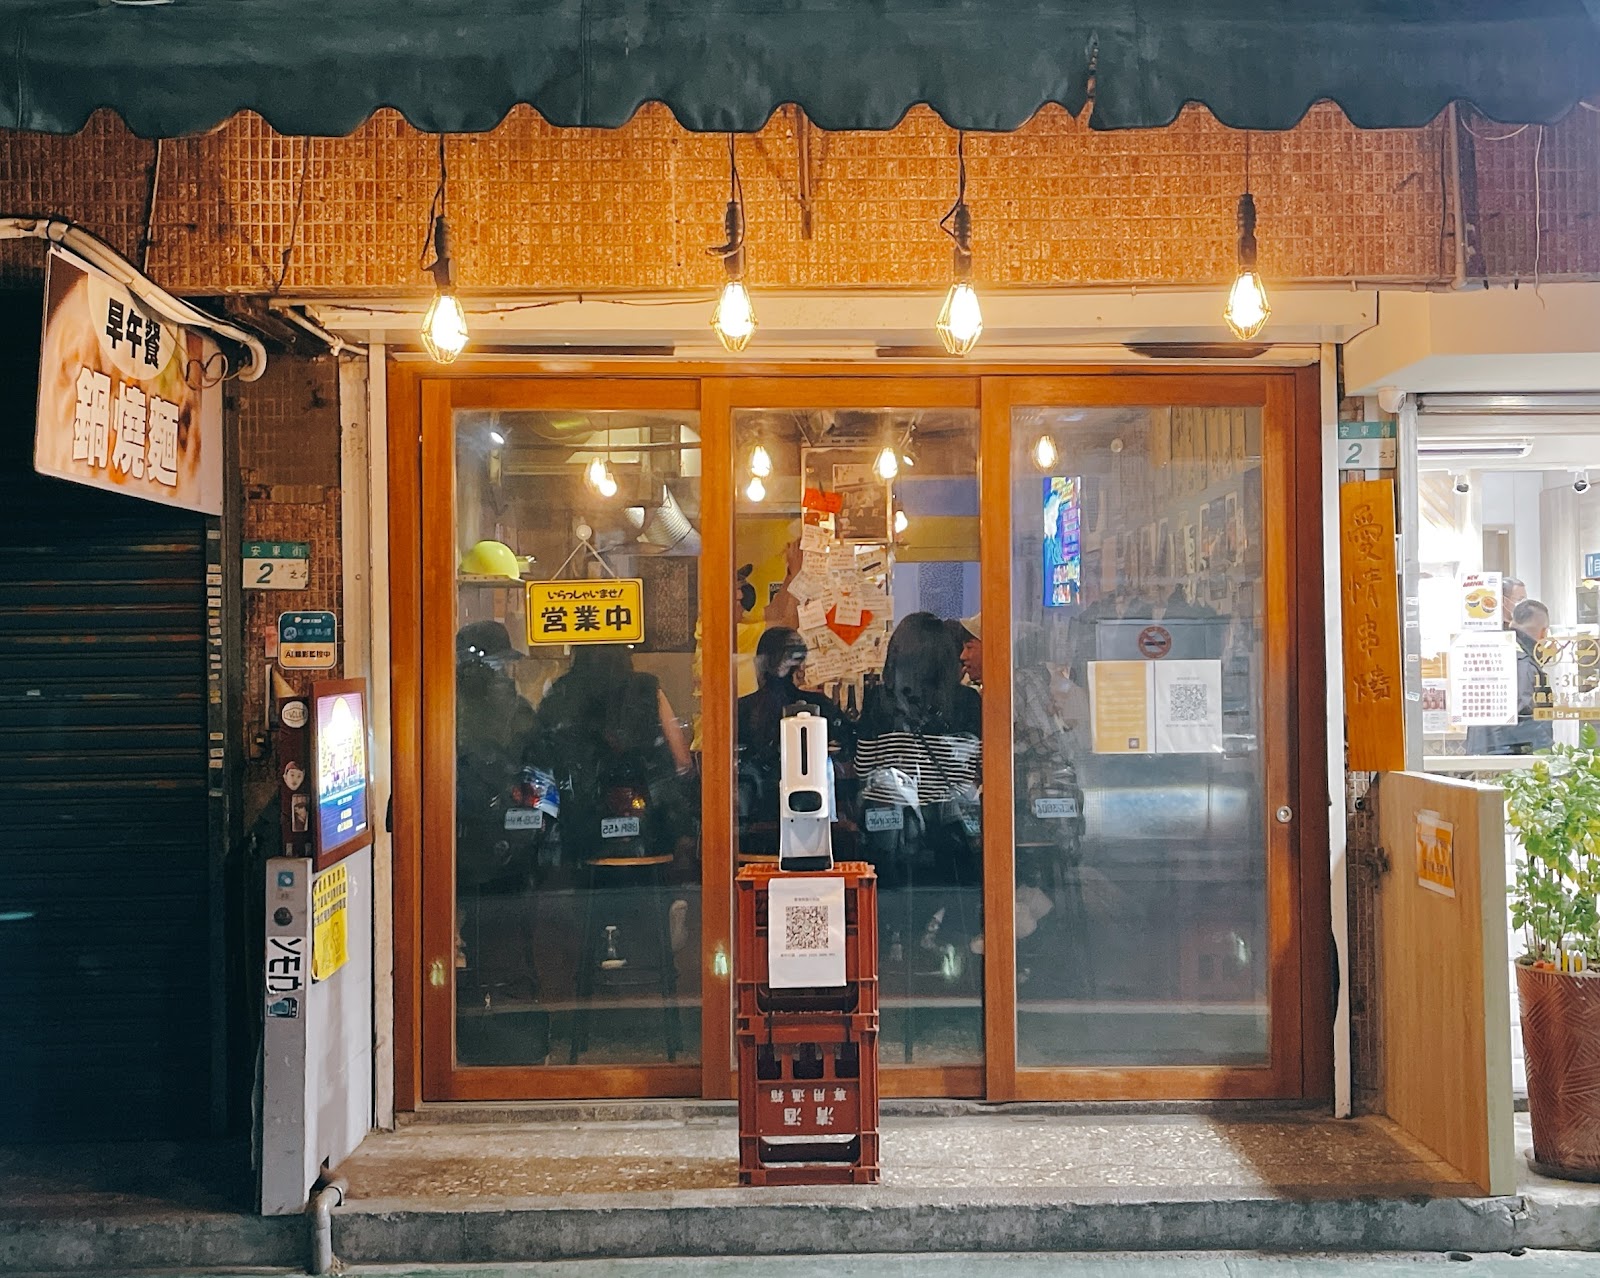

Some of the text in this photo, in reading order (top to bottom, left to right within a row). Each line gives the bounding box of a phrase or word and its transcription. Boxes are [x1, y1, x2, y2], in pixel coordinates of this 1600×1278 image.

[106, 298, 160, 369] 早午餐
[73, 367, 179, 487] 鍋燒麵
[1345, 443, 1362, 463] 2
[250, 545, 303, 557] 安東街
[256, 563, 274, 584] 2
[541, 605, 632, 633] 営業中
